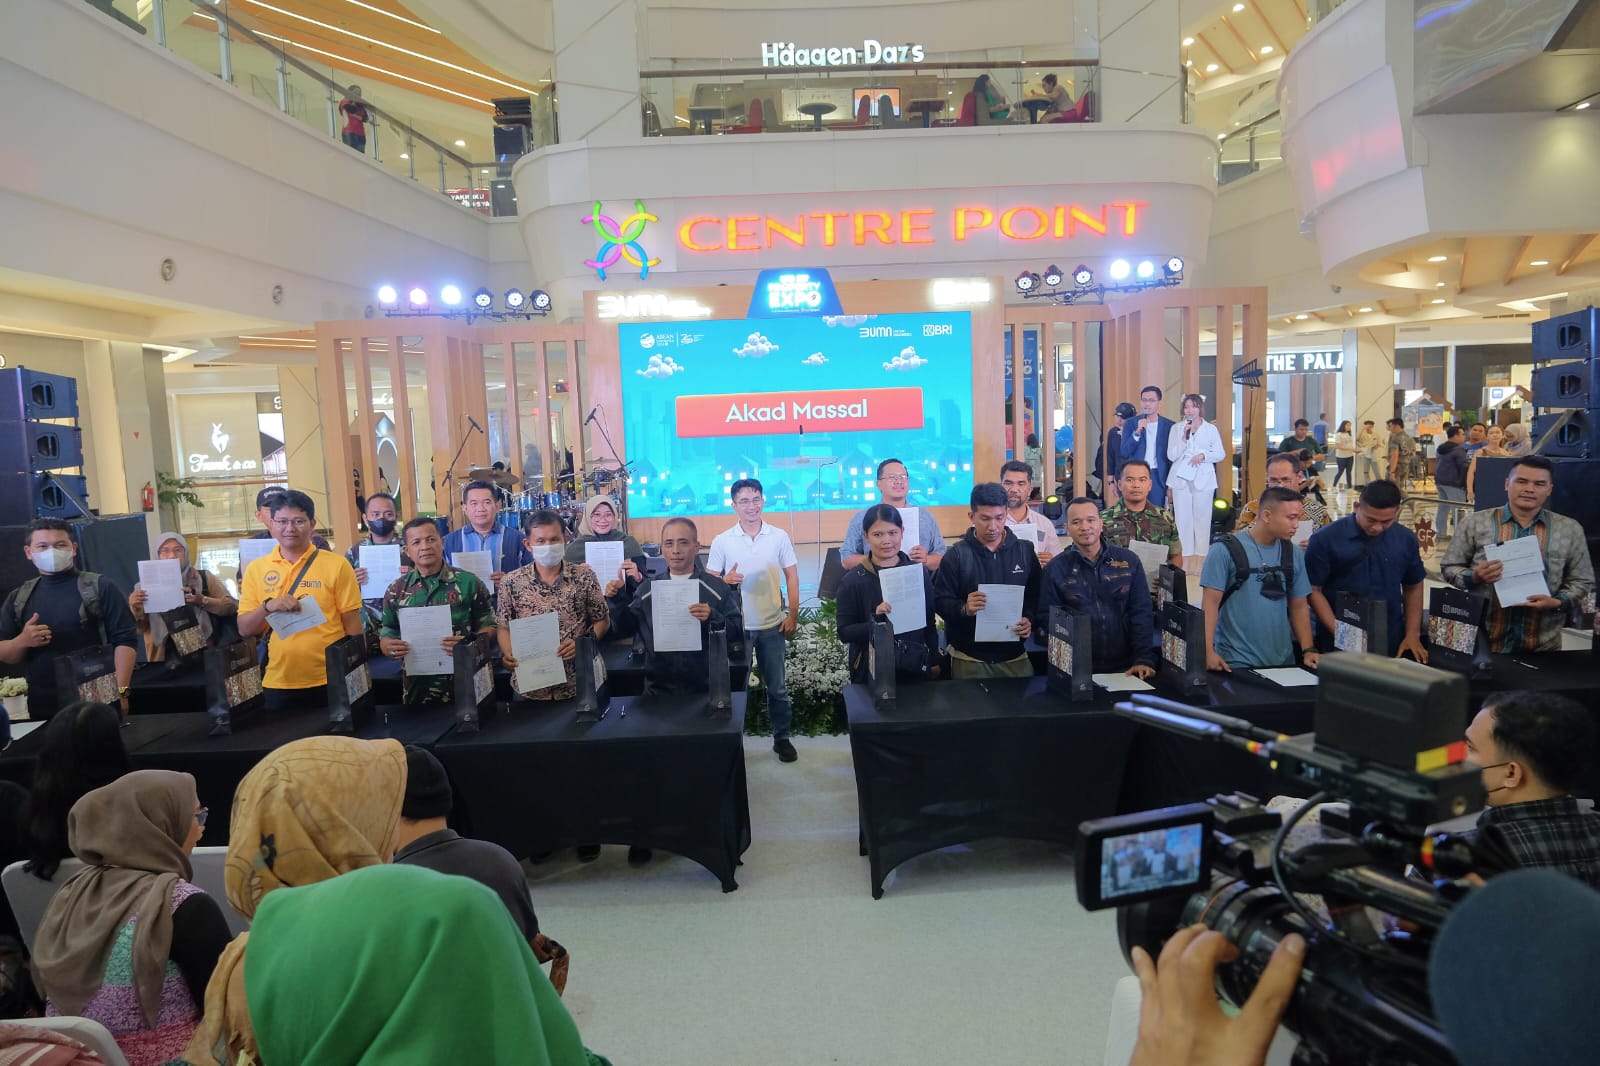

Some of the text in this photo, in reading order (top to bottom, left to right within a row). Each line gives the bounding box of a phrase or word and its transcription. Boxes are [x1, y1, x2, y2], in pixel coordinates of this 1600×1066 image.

[678, 202, 1151, 252] CENTRE POINT
[768, 290, 821, 308] EXPO
[1265, 354, 1296, 371] THE
[725, 398, 868, 423] Akad Massal
